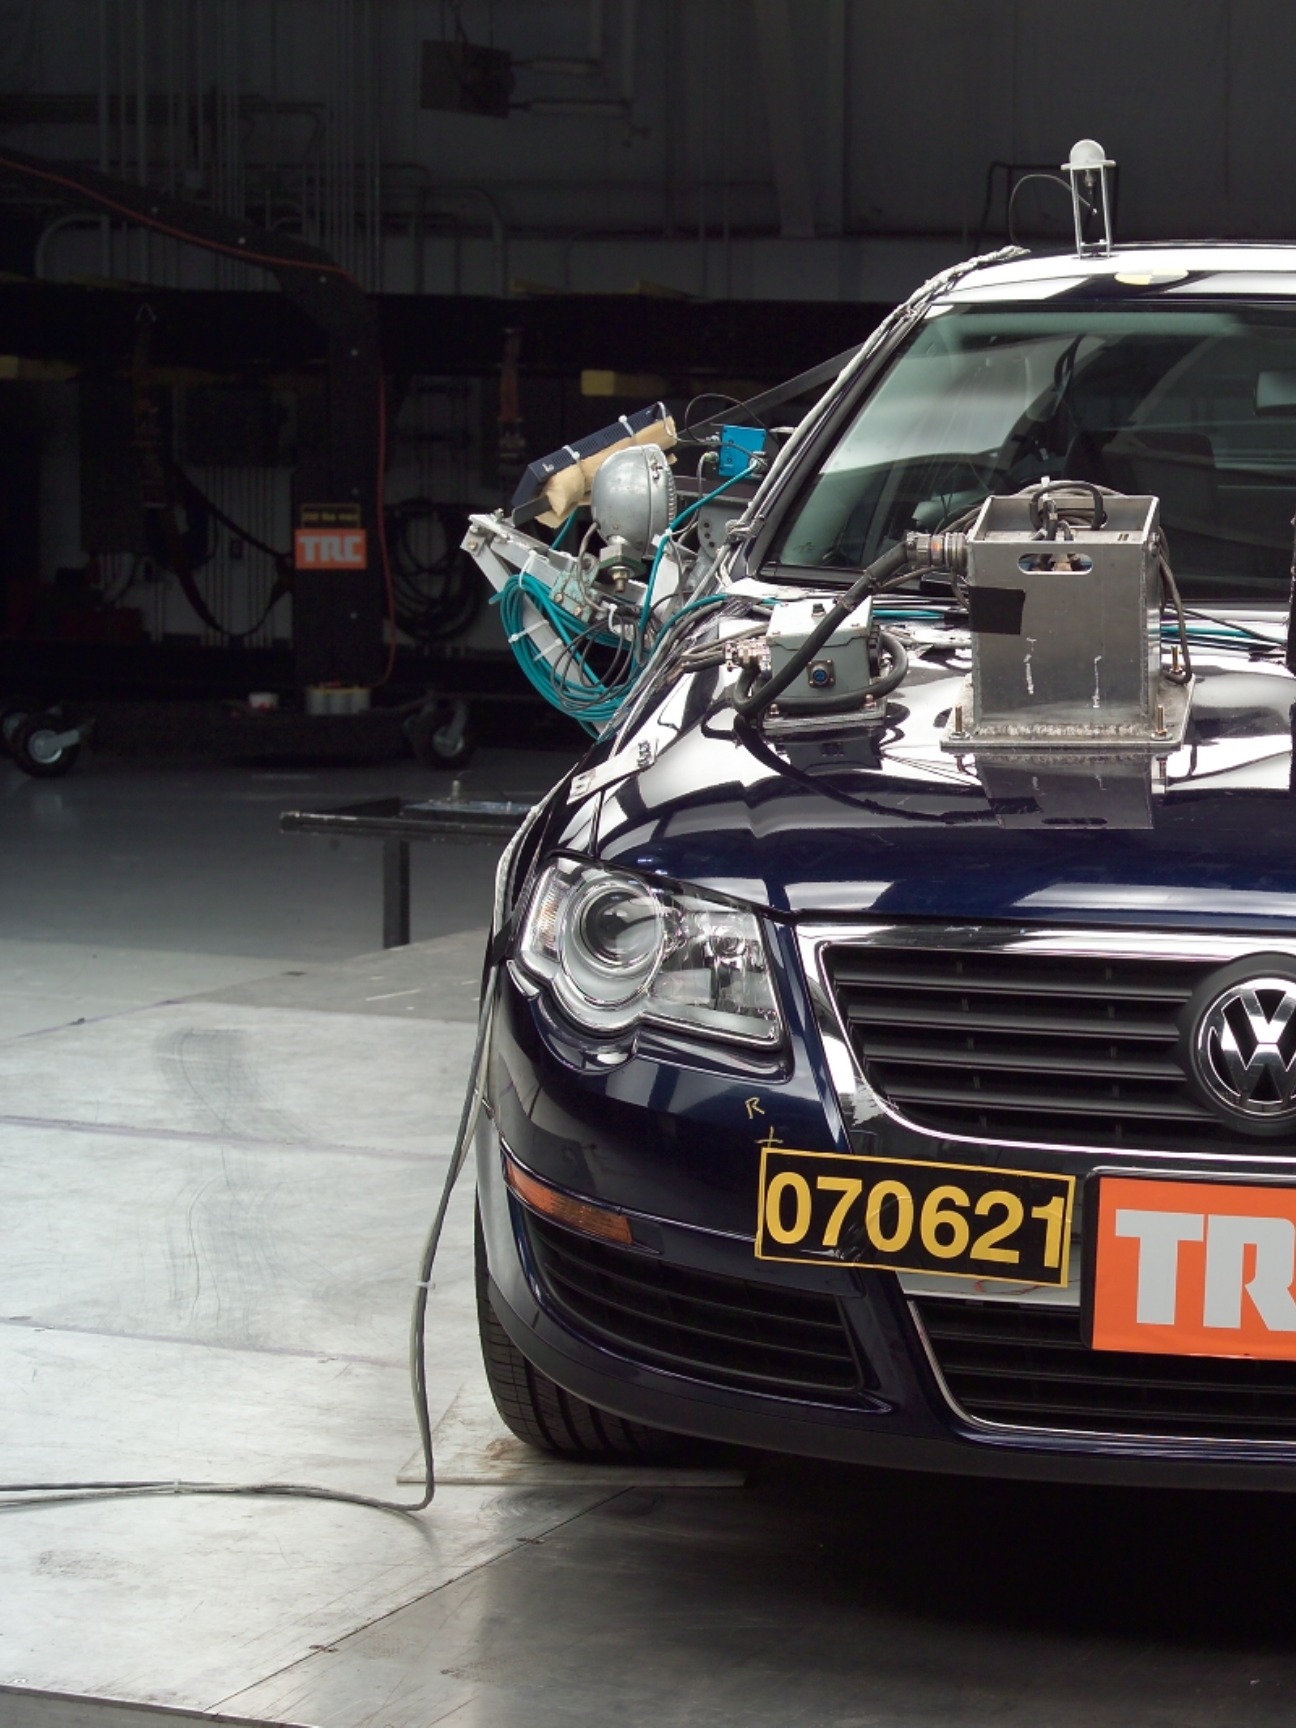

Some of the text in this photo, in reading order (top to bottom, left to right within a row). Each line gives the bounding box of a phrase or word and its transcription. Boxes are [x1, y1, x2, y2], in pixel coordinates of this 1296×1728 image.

[299, 535, 362, 563] TRC
[745, 1096, 765, 1119] R
[765, 1171, 1066, 1269] 070621
